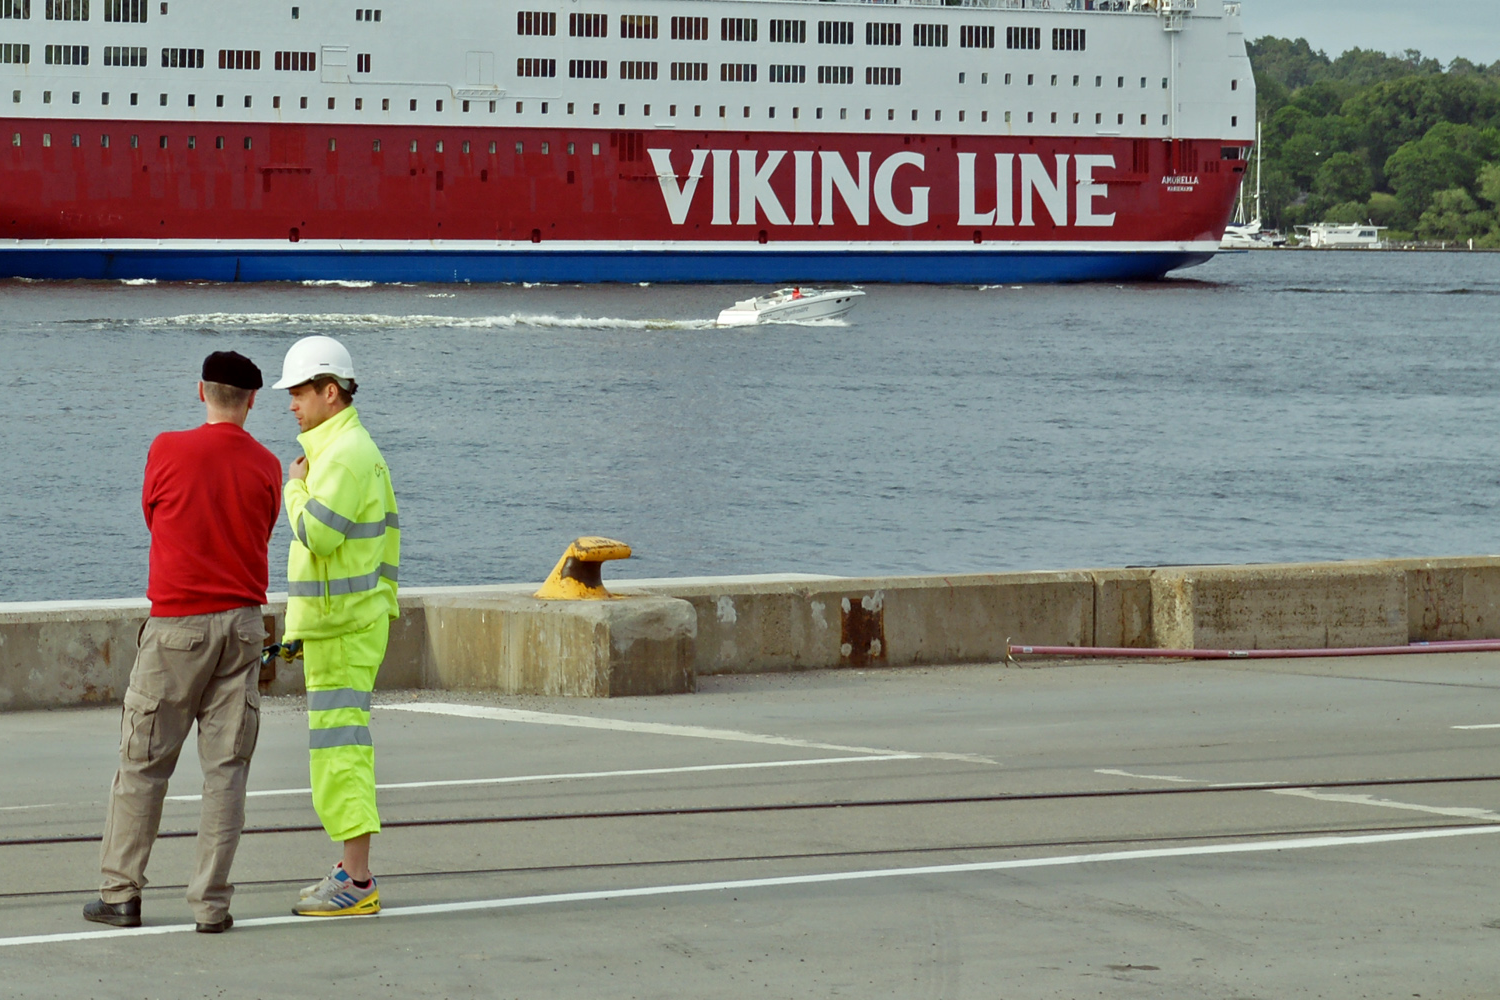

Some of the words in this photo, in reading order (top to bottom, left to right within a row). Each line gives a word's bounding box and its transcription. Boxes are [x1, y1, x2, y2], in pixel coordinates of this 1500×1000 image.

[647, 149, 931, 226] VIKING
[957, 152, 1117, 227] LINE
[1161, 175, 1199, 185] AMORELLA
